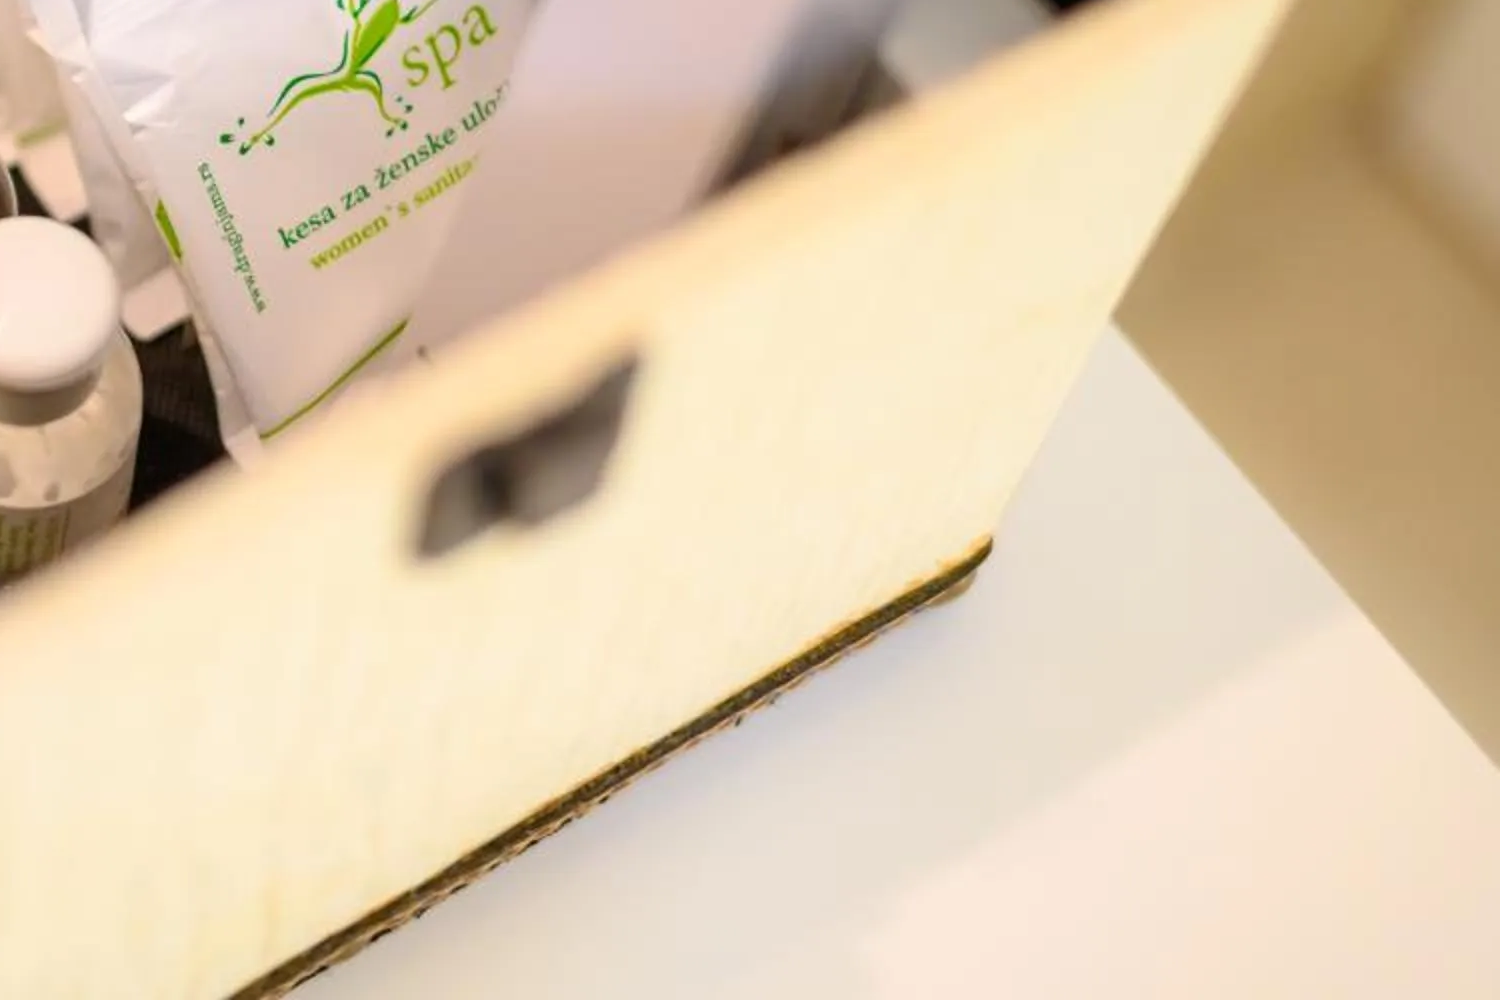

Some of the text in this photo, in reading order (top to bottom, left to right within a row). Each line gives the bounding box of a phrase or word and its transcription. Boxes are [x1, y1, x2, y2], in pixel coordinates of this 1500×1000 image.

[402, 5, 498, 91] spa
[277, 205, 336, 249] kesa
[341, 184, 371, 211] za
[374, 132, 456, 190] ženske
